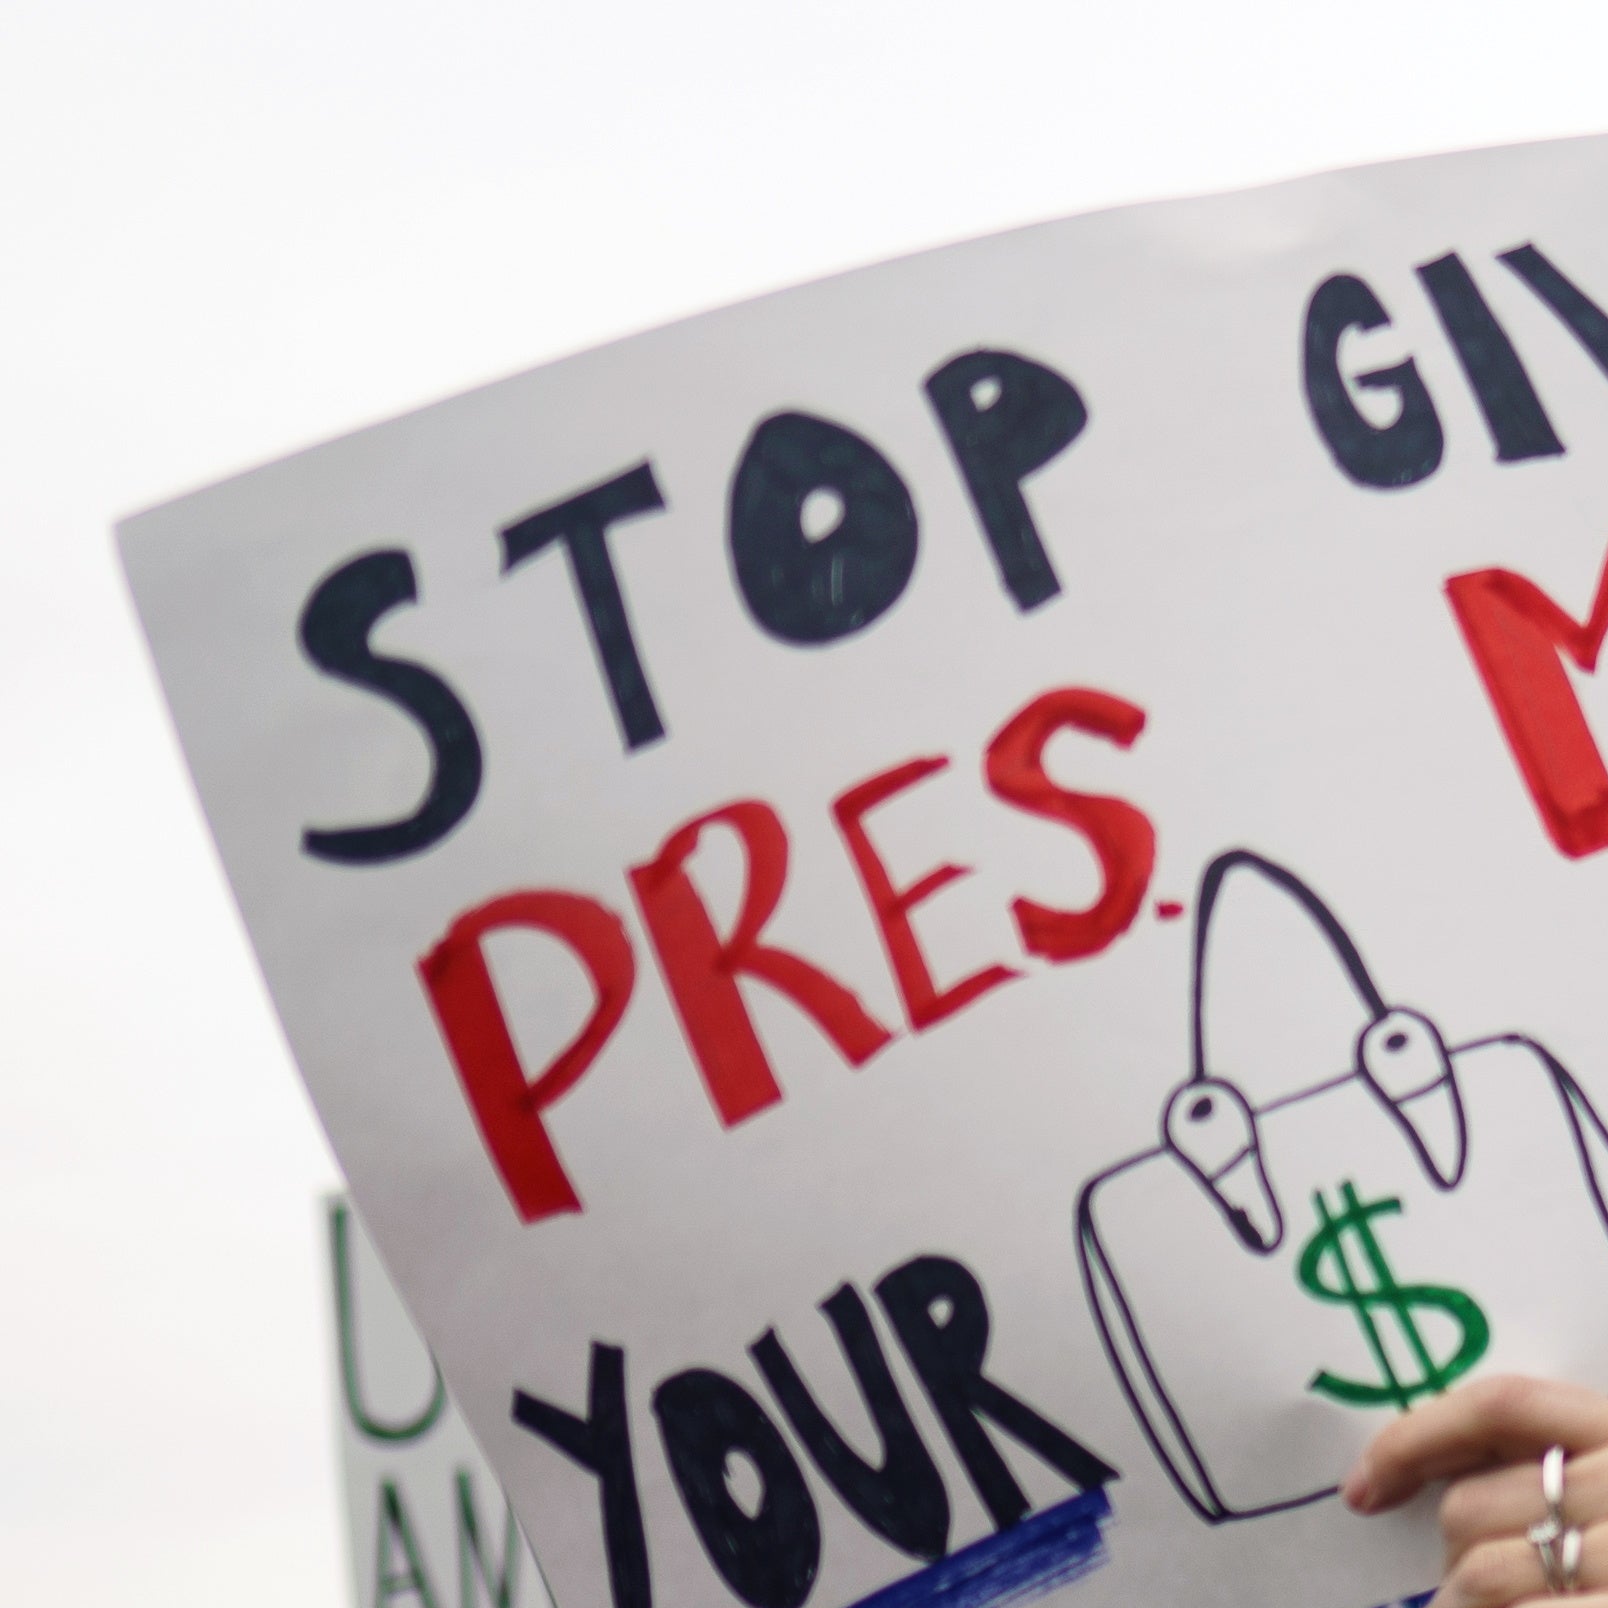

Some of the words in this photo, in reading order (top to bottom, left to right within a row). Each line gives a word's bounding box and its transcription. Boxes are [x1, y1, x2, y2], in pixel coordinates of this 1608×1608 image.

[296, 346, 1089, 867] STOP
[416, 687, 1184, 1226] PRES.
[1295, 1179, 1491, 1409] $
